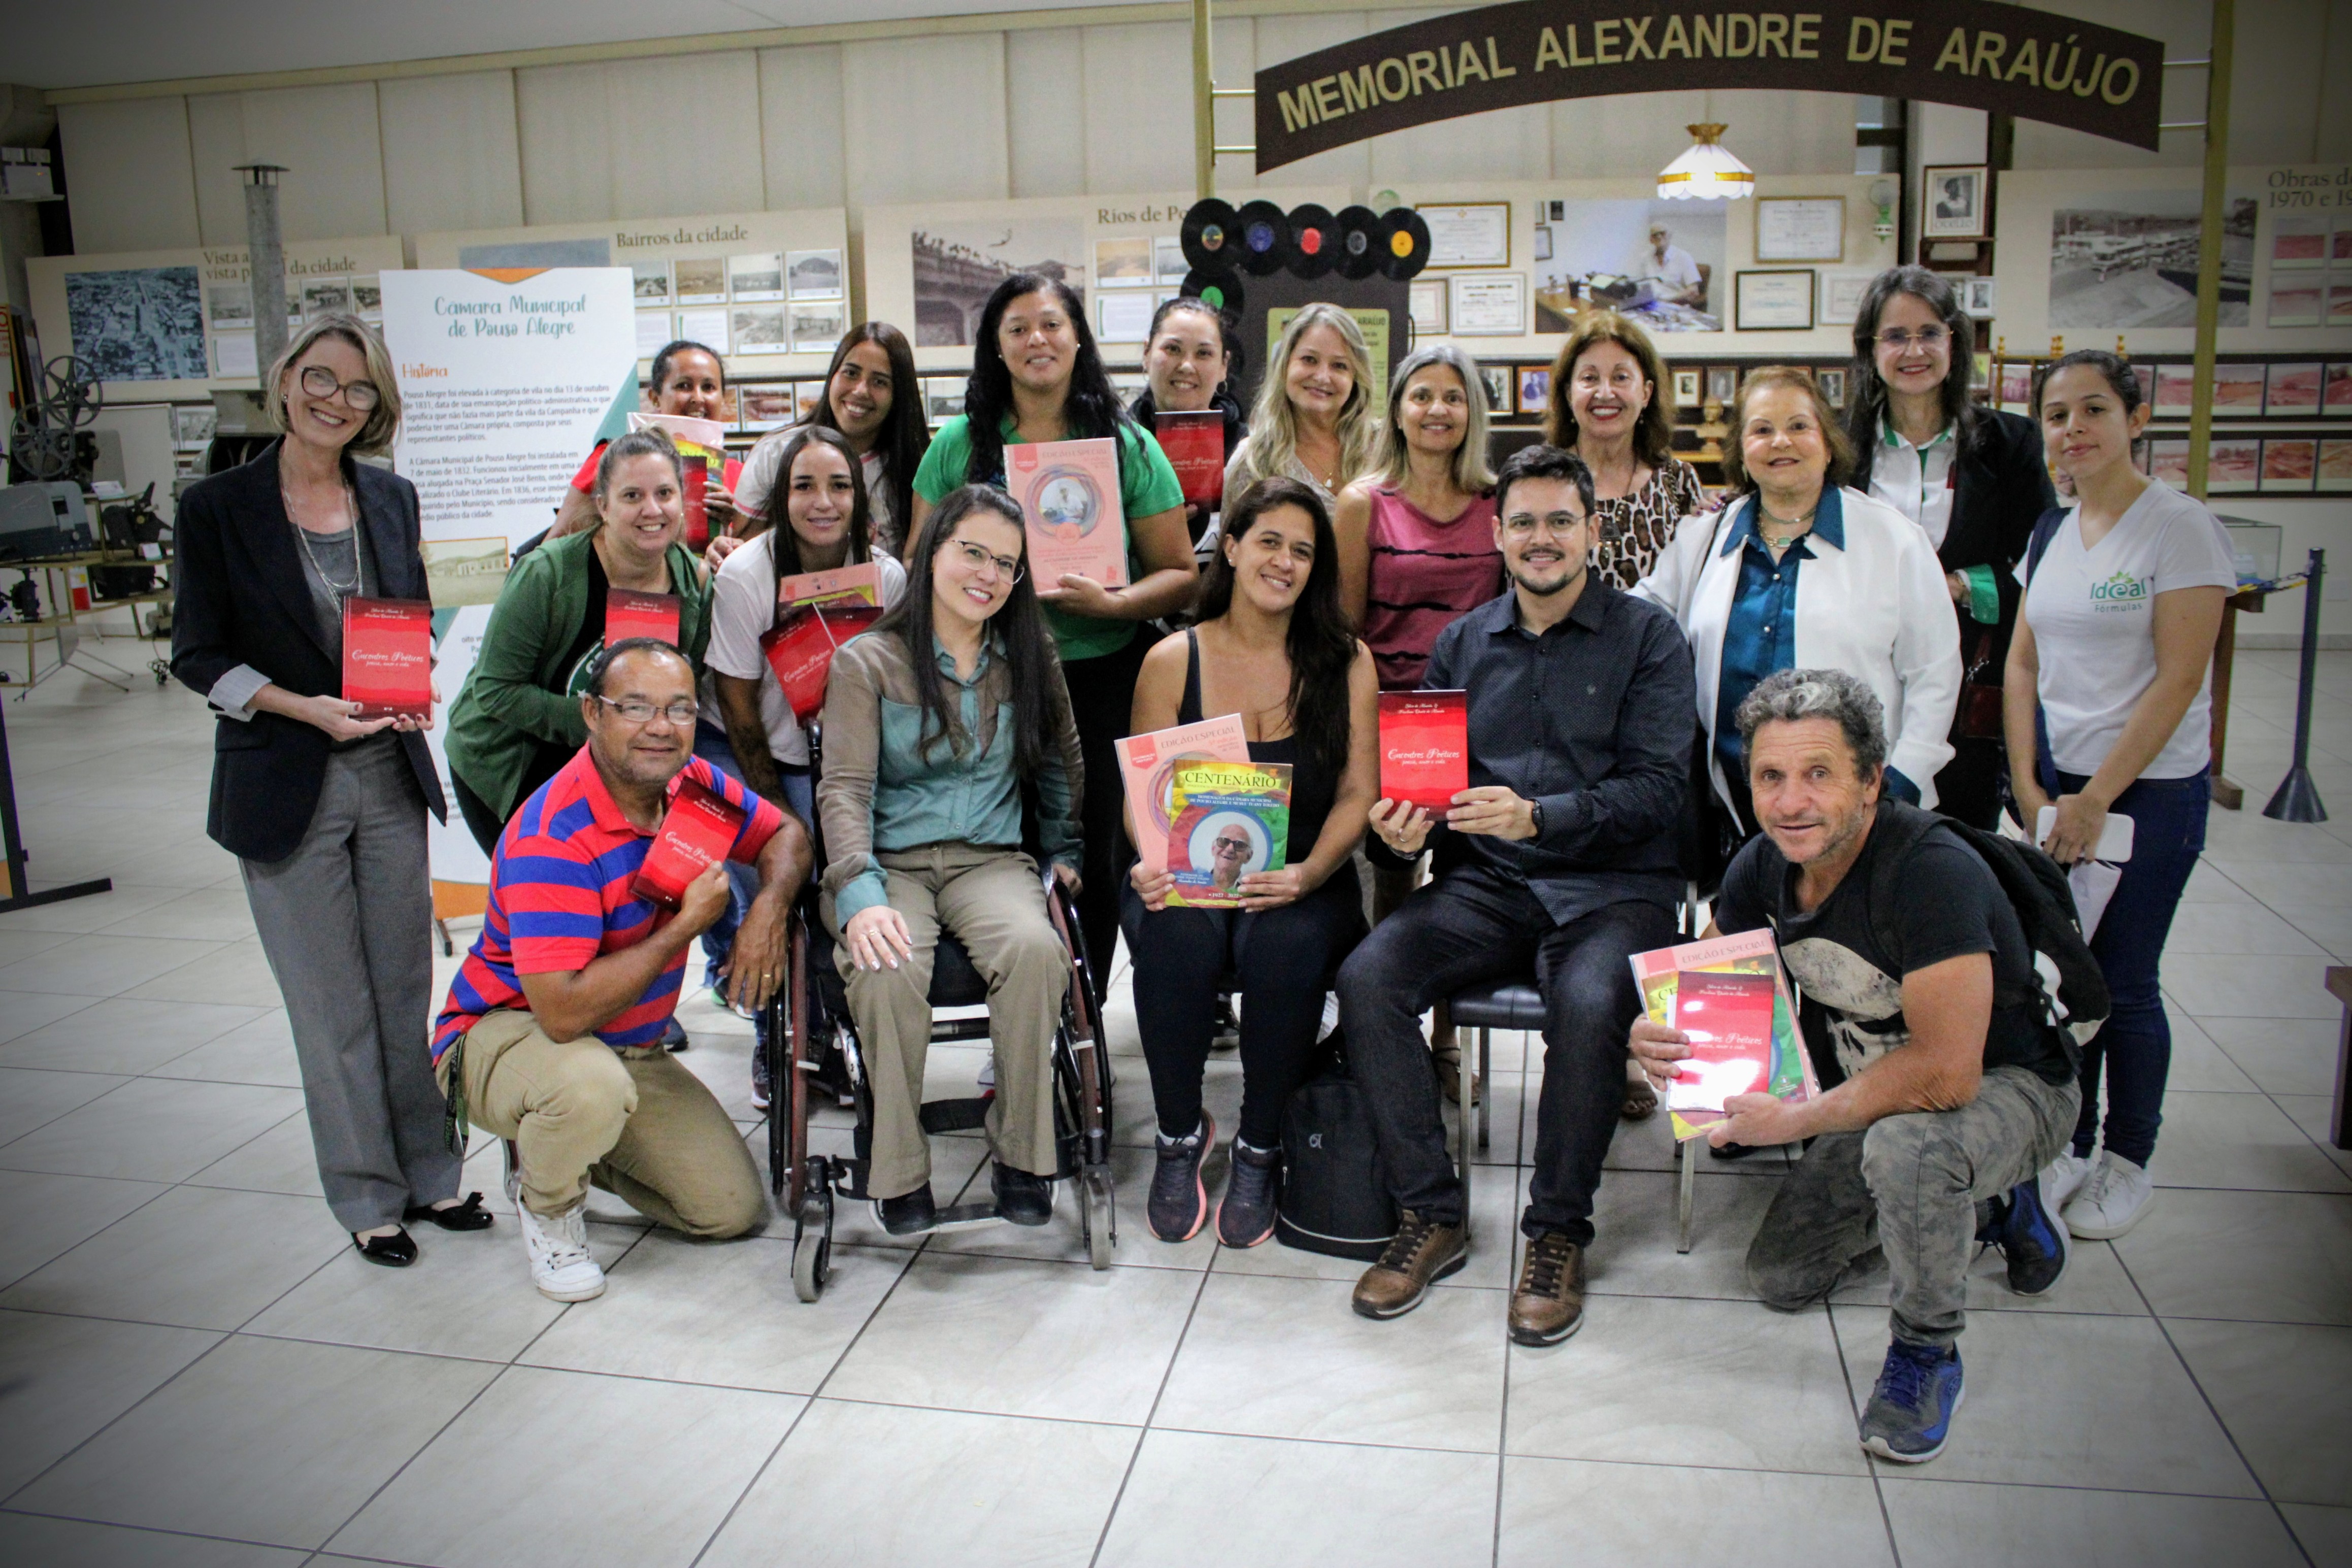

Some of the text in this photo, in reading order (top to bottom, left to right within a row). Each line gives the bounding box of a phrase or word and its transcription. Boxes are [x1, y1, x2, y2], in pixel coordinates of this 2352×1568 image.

[1277, 13, 2140, 133] MEMORIAL ALEXANDRE DE ARAÚJO
[2268, 169, 2329, 187] Obras
[2270, 190, 2314, 208] 1970
[2320, 195, 2330, 207] e
[1098, 208, 1136, 224] Rios
[1140, 205, 1162, 222] de
[616, 225, 748, 248] Bairros da cidade
[203, 251, 238, 265] Vista
[206, 266, 238, 279] vista
[290, 259, 307, 275] da
[310, 255, 356, 274] cidade
[509, 294, 585, 317] Municipal
[448, 317, 575, 339] de Pouso Alegre
[404, 390, 423, 398] Pouso
[425, 390, 446, 399] Alegre
[448, 389, 456, 397] foi
[458, 389, 483, 397] elevada
[490, 388, 520, 396] categoria
[474, 398, 516, 408] emancipação
[462, 411, 478, 419] fazia
[496, 409, 513, 419] parte
[515, 408, 523, 416] da
[525, 408, 536, 416] vila
[538, 407, 545, 415] da
[547, 407, 580, 416] Campanha
[587, 406, 600, 414] que
[407, 424, 432, 433] poderia
[513, 419, 544, 428] composta
[546, 419, 556, 428] por
[407, 435, 456, 444] representantes
[442, 455, 474, 464] Municipal
[485, 454, 504, 462] Pouso
[506, 453, 526, 462] Alegre
[538, 451, 567, 459] instalada
[473, 465, 506, 474] Funcionou
[508, 463, 547, 472] inicialmente
[427, 479, 453, 488] alugada
[465, 478, 482, 486] Praça
[512, 475, 525, 483] José
[452, 489, 470, 497] Clube
[446, 502, 460, 510] pelo
[497, 497, 516, 505] sendo
[517, 495, 555, 505] considerado
[437, 512, 460, 521] público
[2090, 578, 2147, 599] Ideal
[1161, 726, 1236, 749] EDIÇÃO ESPECIAL
[1388, 748, 1460, 761] Encontros Poéticos
[1185, 772, 1276, 787] CENTENÁRIO
[1682, 941, 1767, 963] EDIÇÃO ESPECIAL
